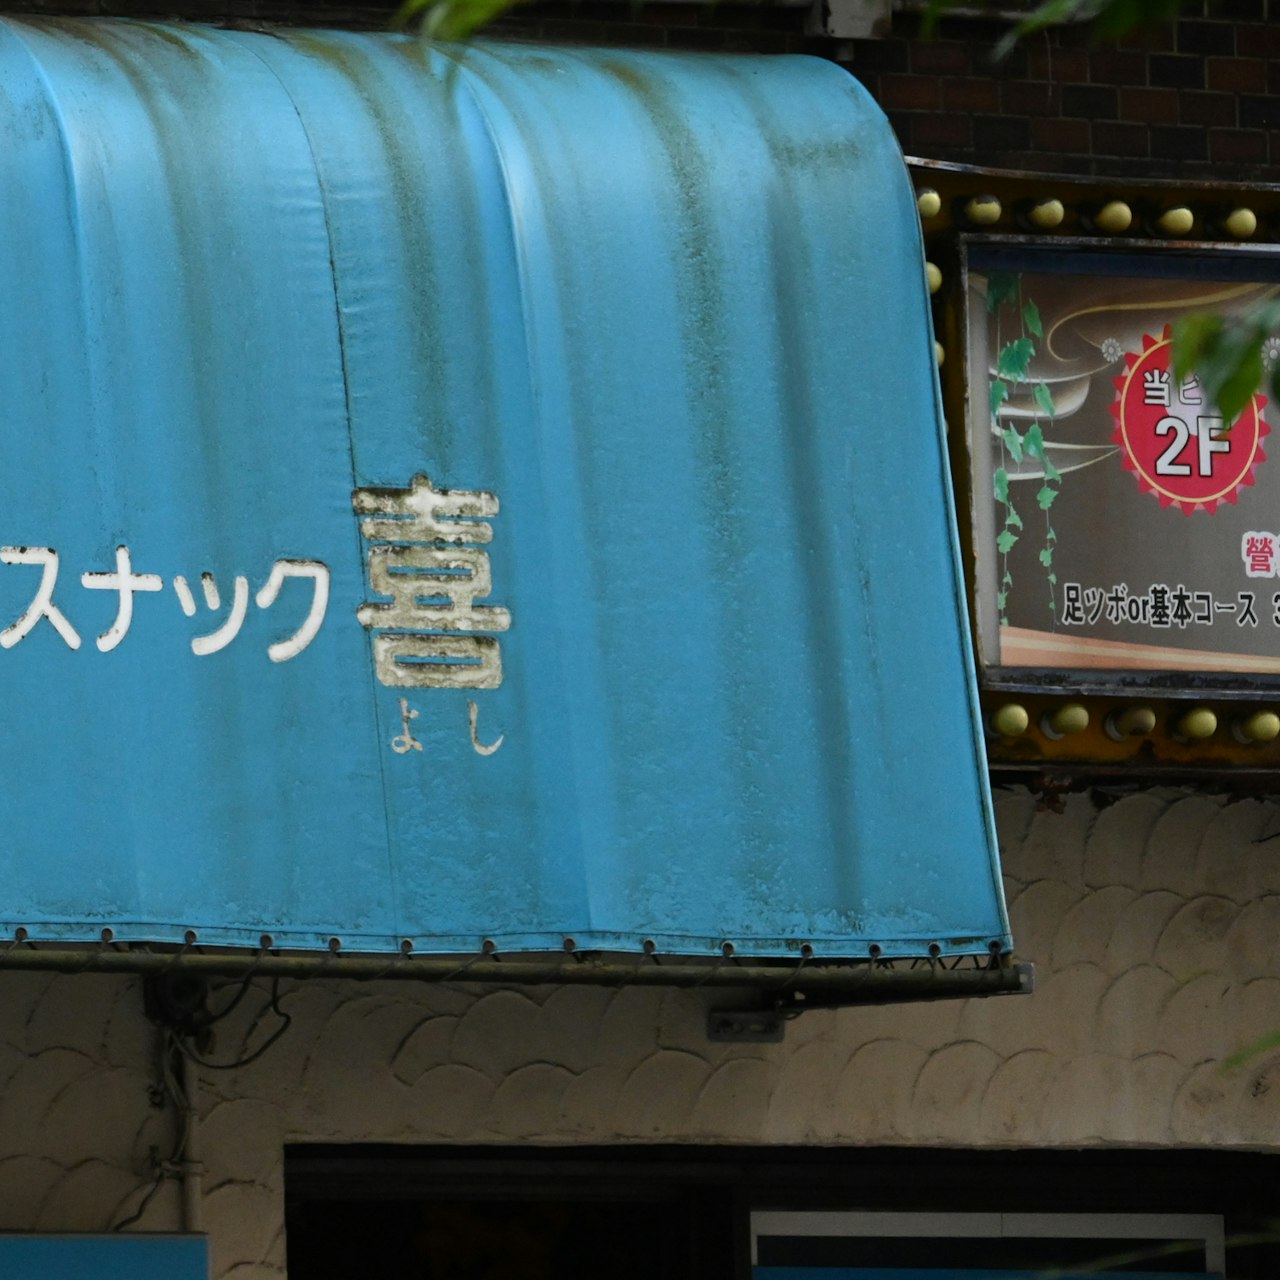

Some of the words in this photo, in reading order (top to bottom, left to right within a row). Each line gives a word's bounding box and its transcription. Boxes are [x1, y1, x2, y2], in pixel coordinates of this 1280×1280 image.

[1142, 368, 1204, 408] 当ビ
[1154, 416, 1232, 478] 2F
[1063, 584, 1258, 627] 足ツボor基本コース
